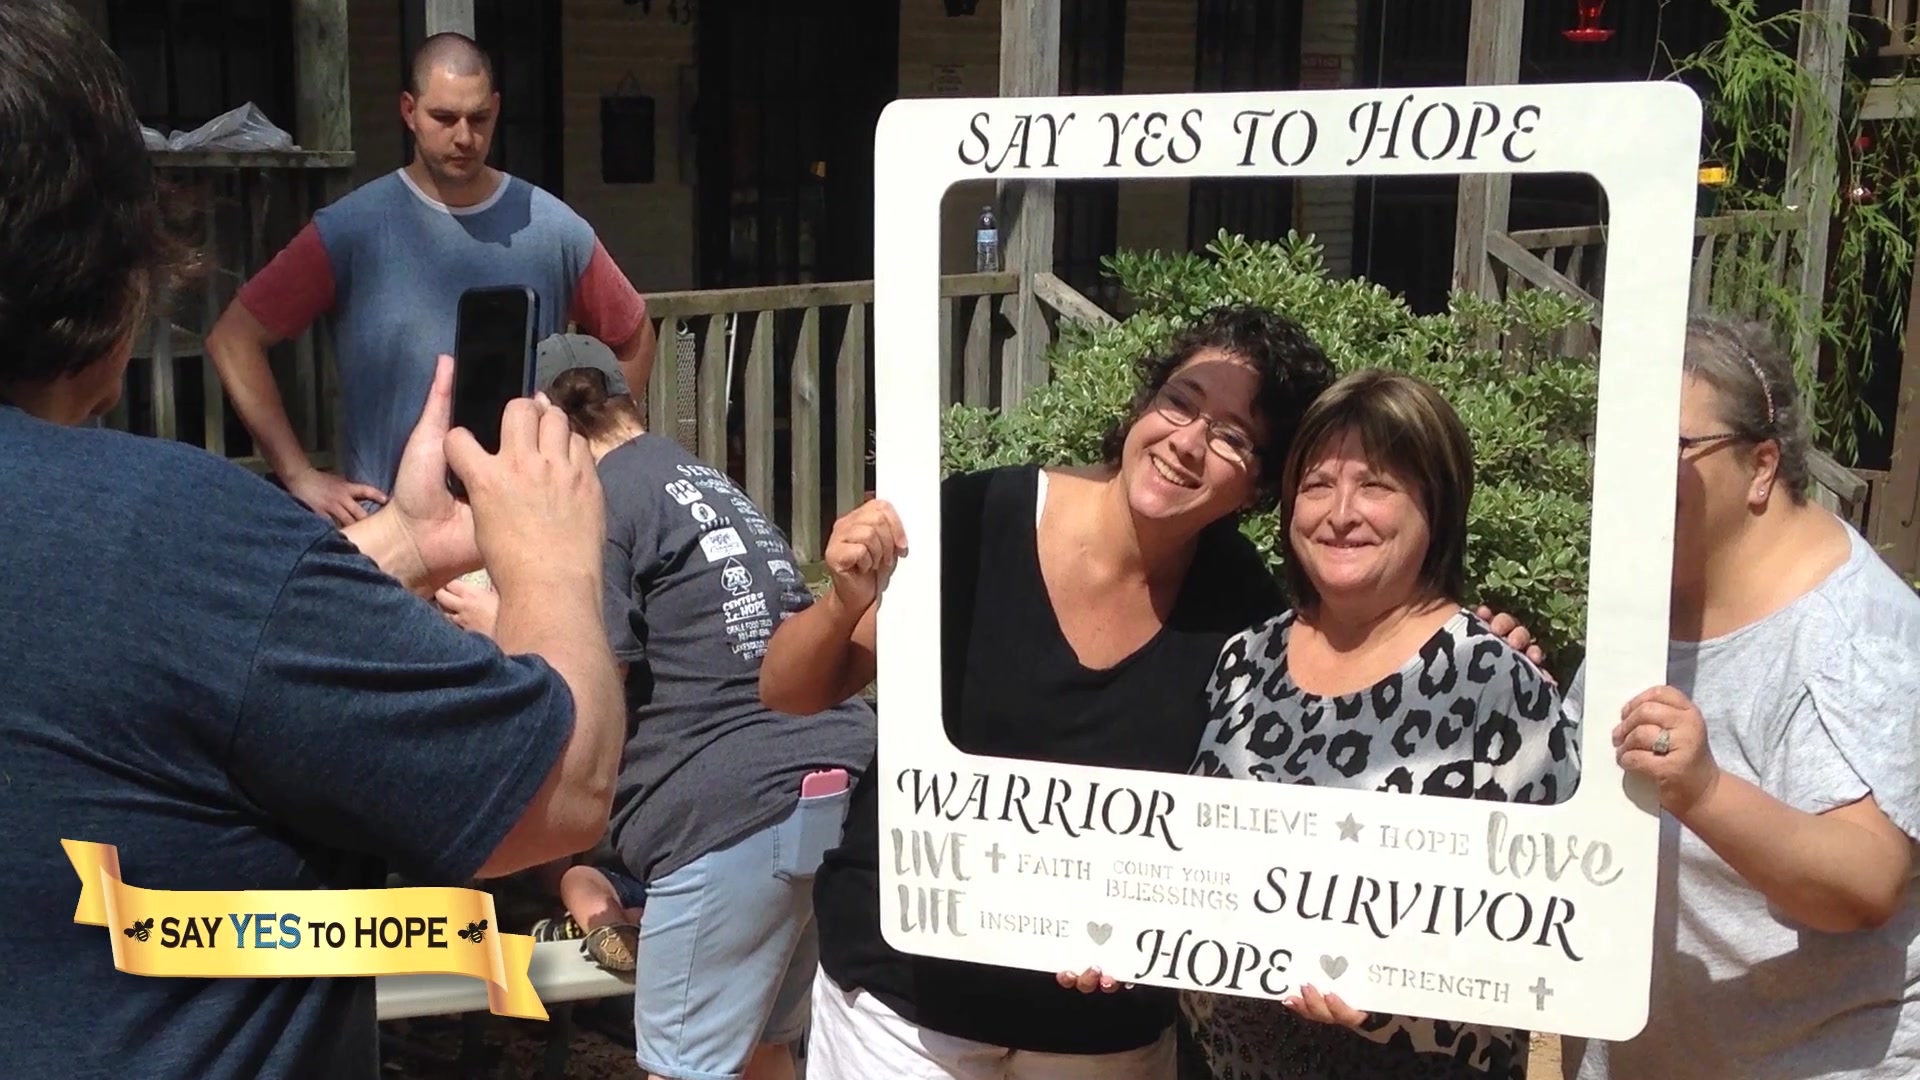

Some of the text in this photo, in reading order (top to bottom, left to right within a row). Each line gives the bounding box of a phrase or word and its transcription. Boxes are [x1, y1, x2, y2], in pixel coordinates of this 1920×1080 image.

[958, 94, 1541, 173] SAY YES TO HOPE
[740, 598, 767, 617] HOPE
[896, 767, 1319, 853] WARRIOR BELIEVE
[890, 827, 973, 883] LIVE
[1379, 824, 1470, 857] HOPE
[1486, 810, 1625, 888] love
[1017, 853, 1092, 881] FAITH
[1112, 859, 1233, 887] COUNT YOUR
[897, 883, 969, 938] LIFE
[1105, 878, 1240, 912] BLESSINGS
[1253, 866, 1585, 963] SURVIVOR
[979, 910, 1071, 939] INSPIRE
[1134, 928, 1293, 996] HOPE
[1367, 963, 1512, 1005] STRENGTH
